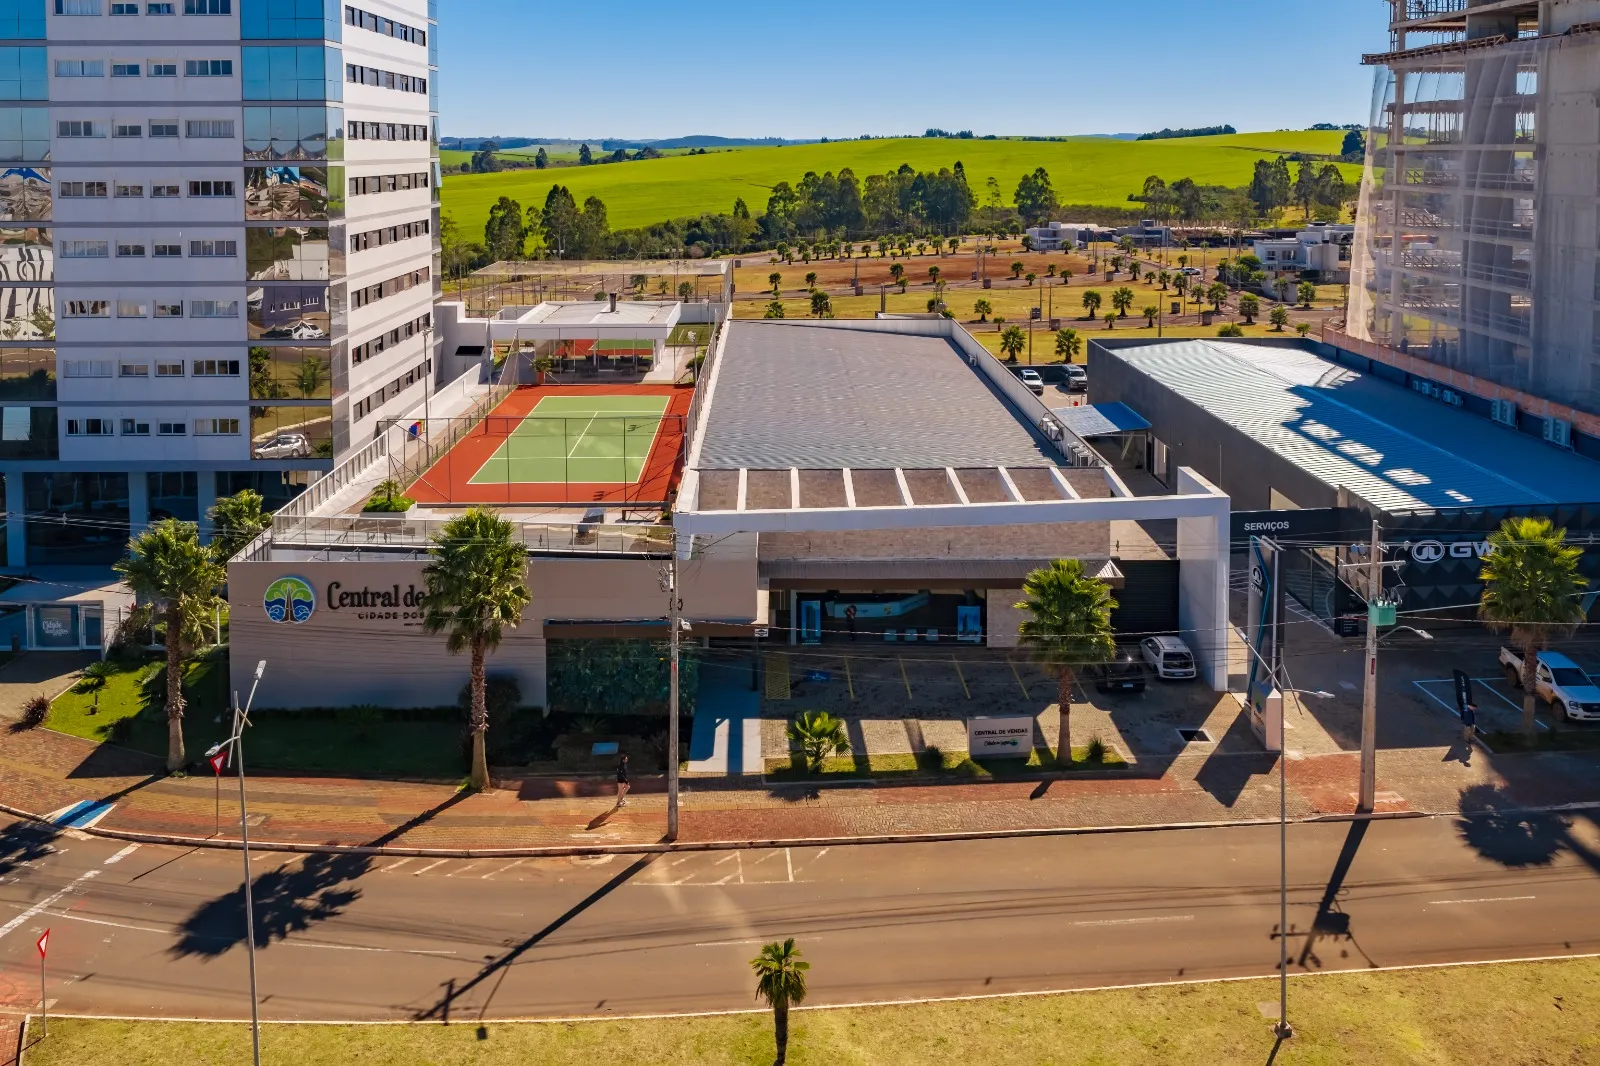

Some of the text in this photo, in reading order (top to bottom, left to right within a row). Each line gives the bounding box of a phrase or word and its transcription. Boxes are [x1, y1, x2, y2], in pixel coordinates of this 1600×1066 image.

[1244, 521, 1290, 531] SERVIÇOS
[1449, 541, 1498, 558] GW
[326, 581, 426, 610] Central de
[358, 611, 425, 620] CIDADE DOS
